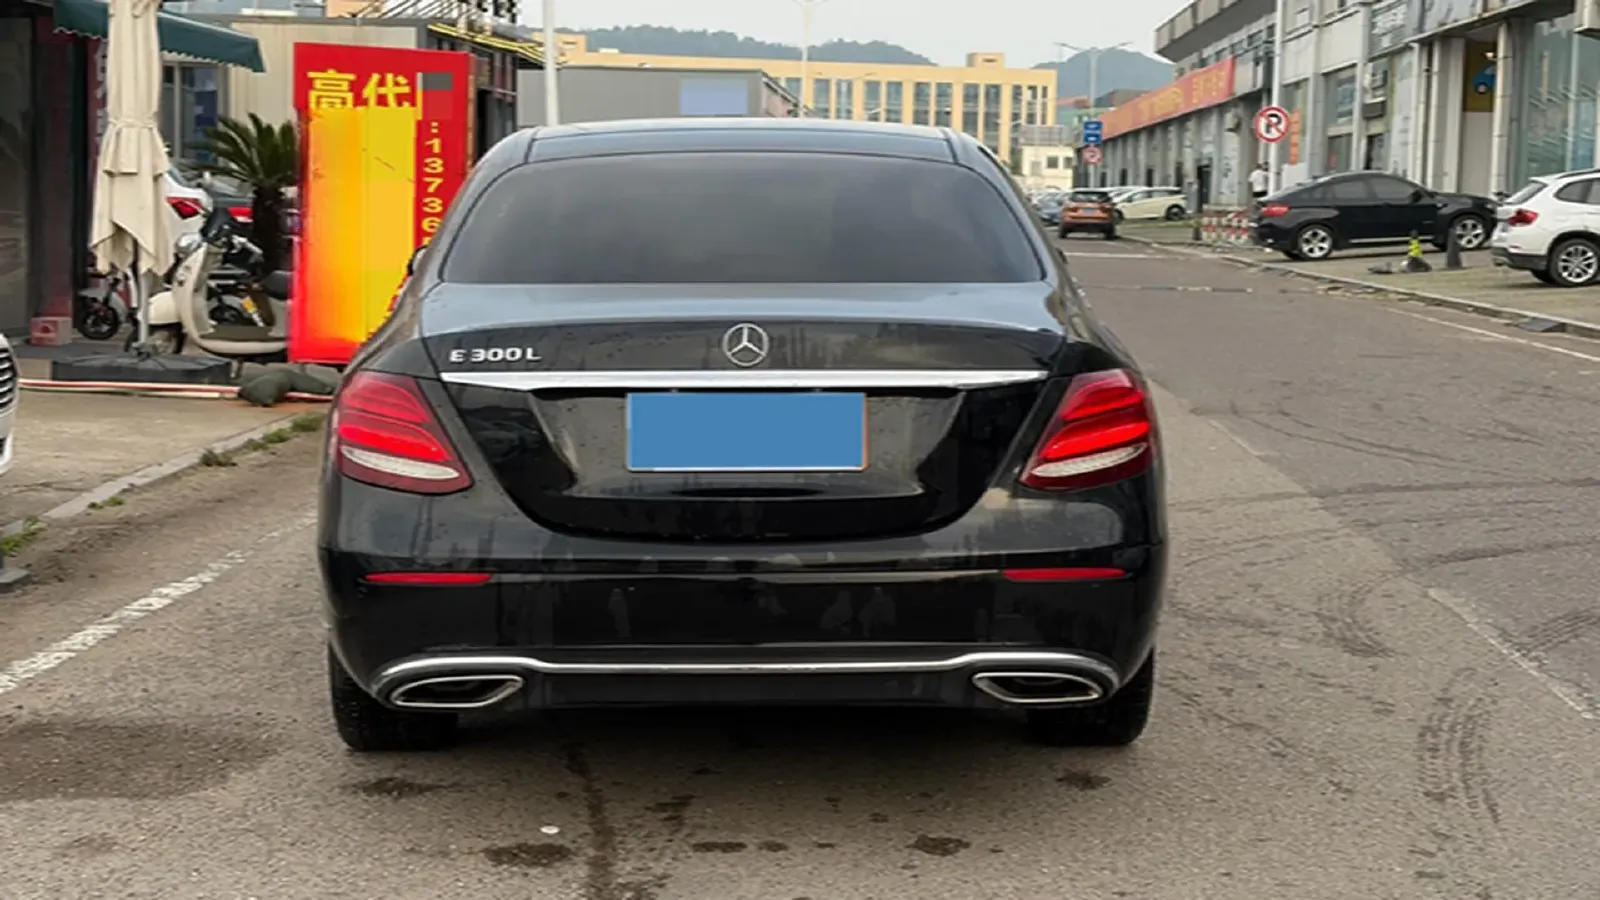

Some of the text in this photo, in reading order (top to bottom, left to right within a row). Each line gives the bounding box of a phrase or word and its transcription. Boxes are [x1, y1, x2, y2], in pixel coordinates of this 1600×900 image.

[449, 346, 542, 362] E 300 L
